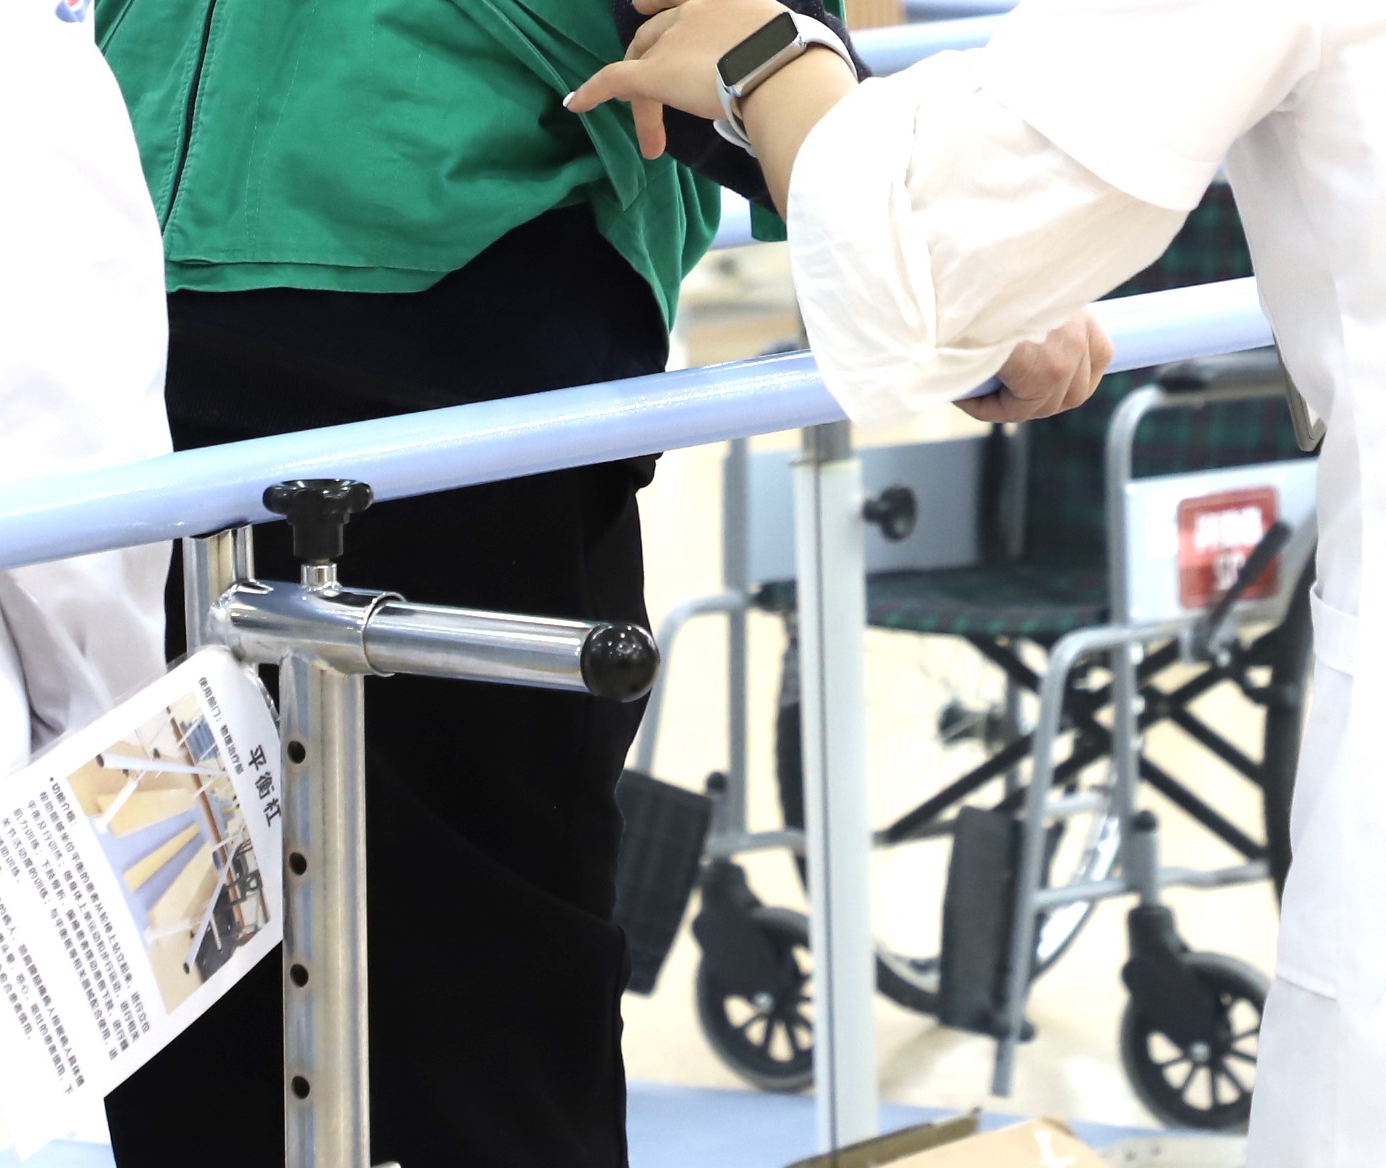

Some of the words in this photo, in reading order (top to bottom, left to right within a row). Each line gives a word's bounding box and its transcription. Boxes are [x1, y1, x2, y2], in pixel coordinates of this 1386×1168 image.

[199, 677, 244, 775] 使用部门：物理治疗部
[248, 744, 283, 828] 平衡杠
